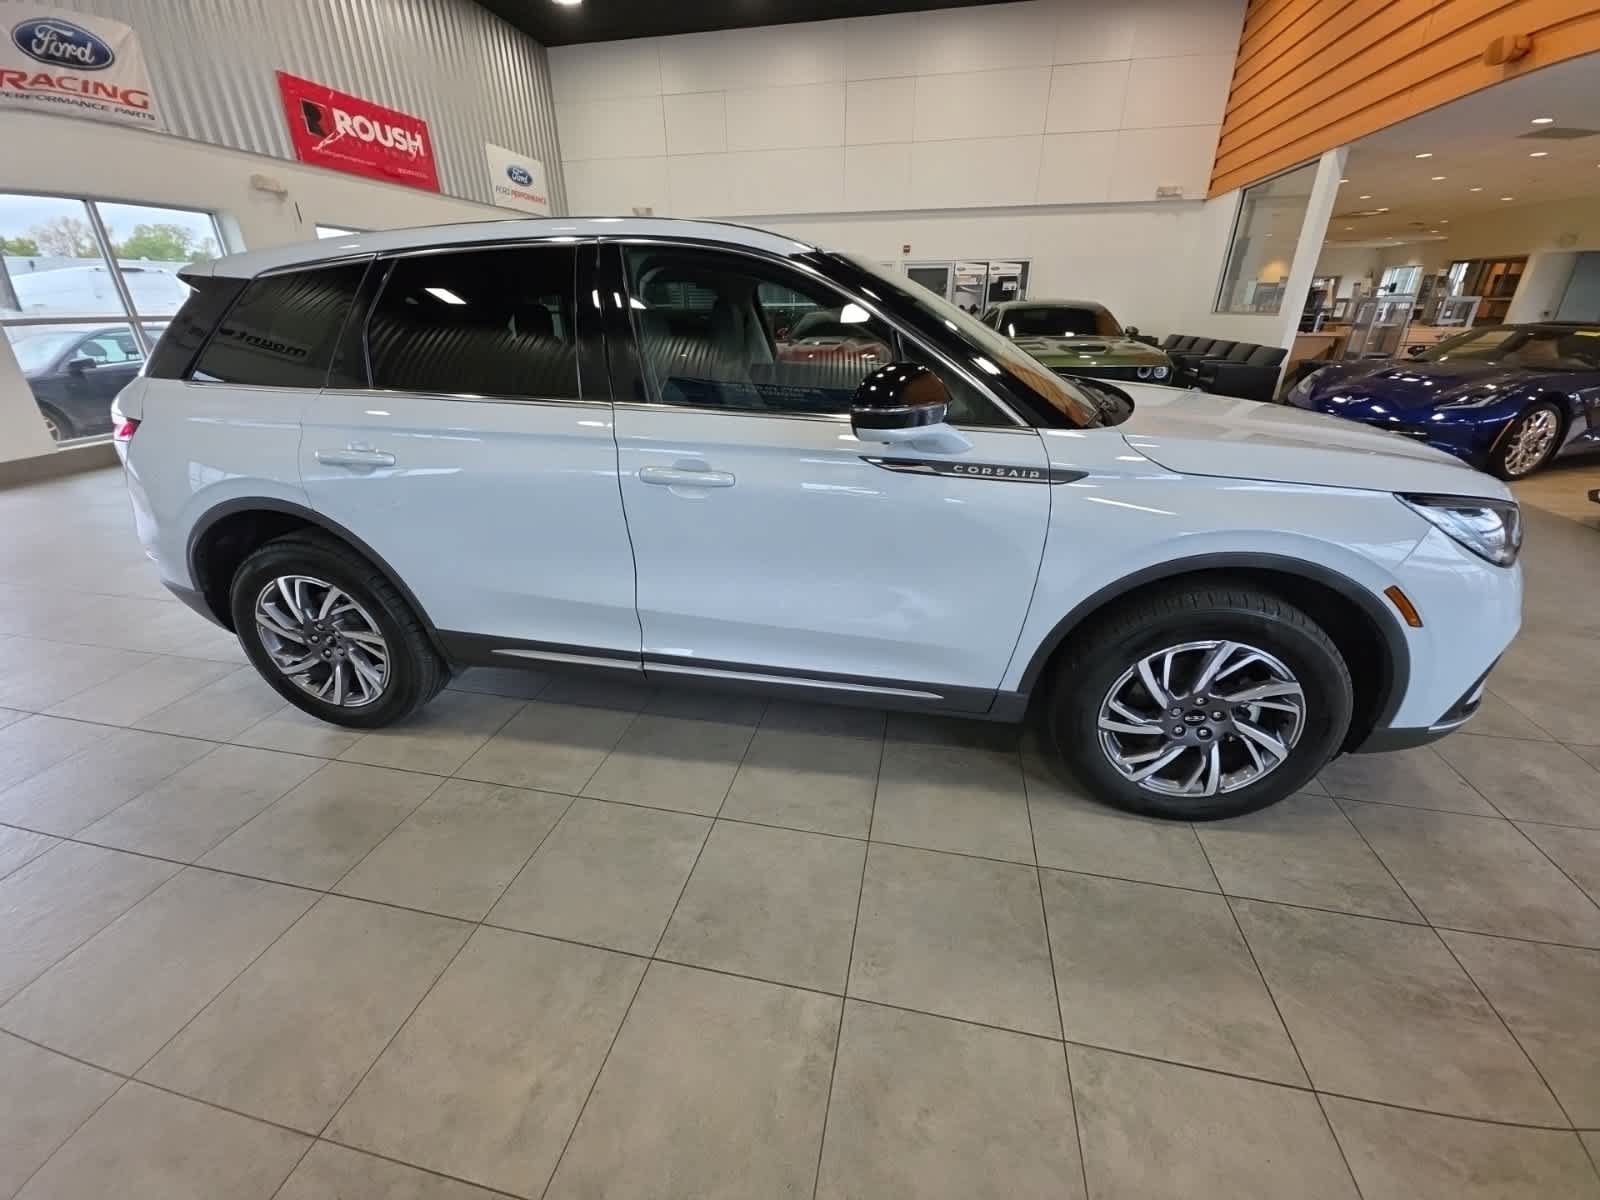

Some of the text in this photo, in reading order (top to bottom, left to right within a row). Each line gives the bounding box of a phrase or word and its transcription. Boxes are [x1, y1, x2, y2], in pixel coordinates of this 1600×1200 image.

[32, 24, 95, 63] Ford
[0, 69, 149, 110] RACING
[114, 107, 155, 121] PARTS
[332, 107, 425, 158] ROUSH
[511, 167, 529, 184] Ford
[953, 464, 1039, 478] CORSAIR
